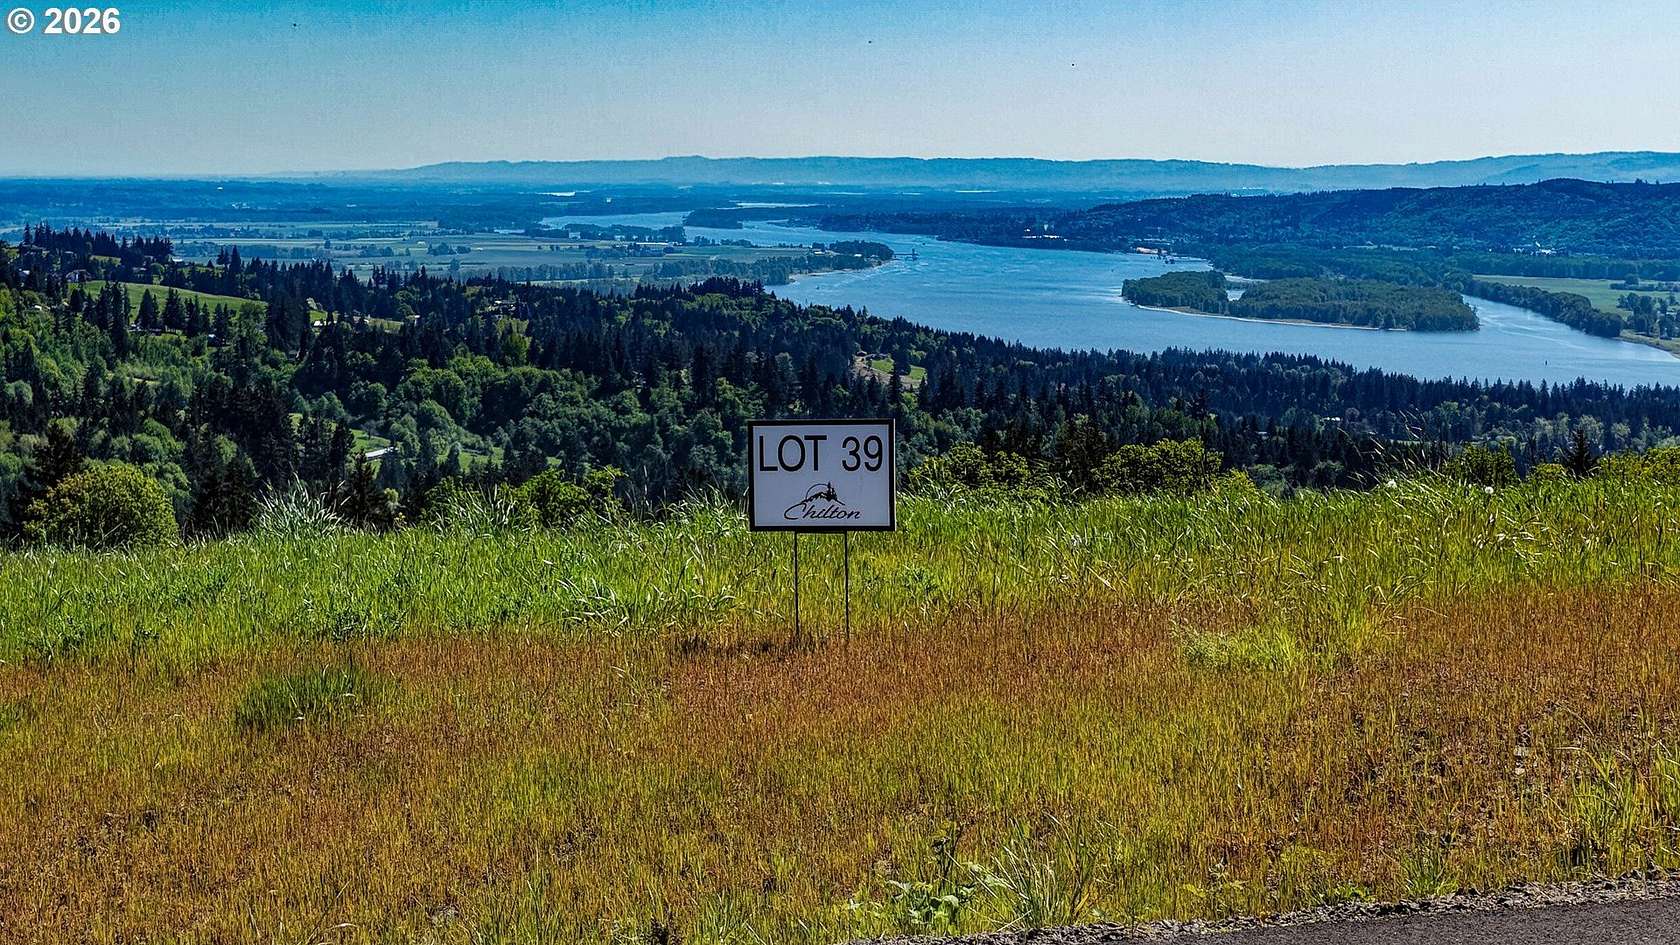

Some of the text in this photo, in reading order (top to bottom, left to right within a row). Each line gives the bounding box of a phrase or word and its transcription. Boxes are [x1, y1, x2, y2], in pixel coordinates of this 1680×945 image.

[759, 434, 883, 472] LOT 39
[783, 502, 861, 521] Chilton
